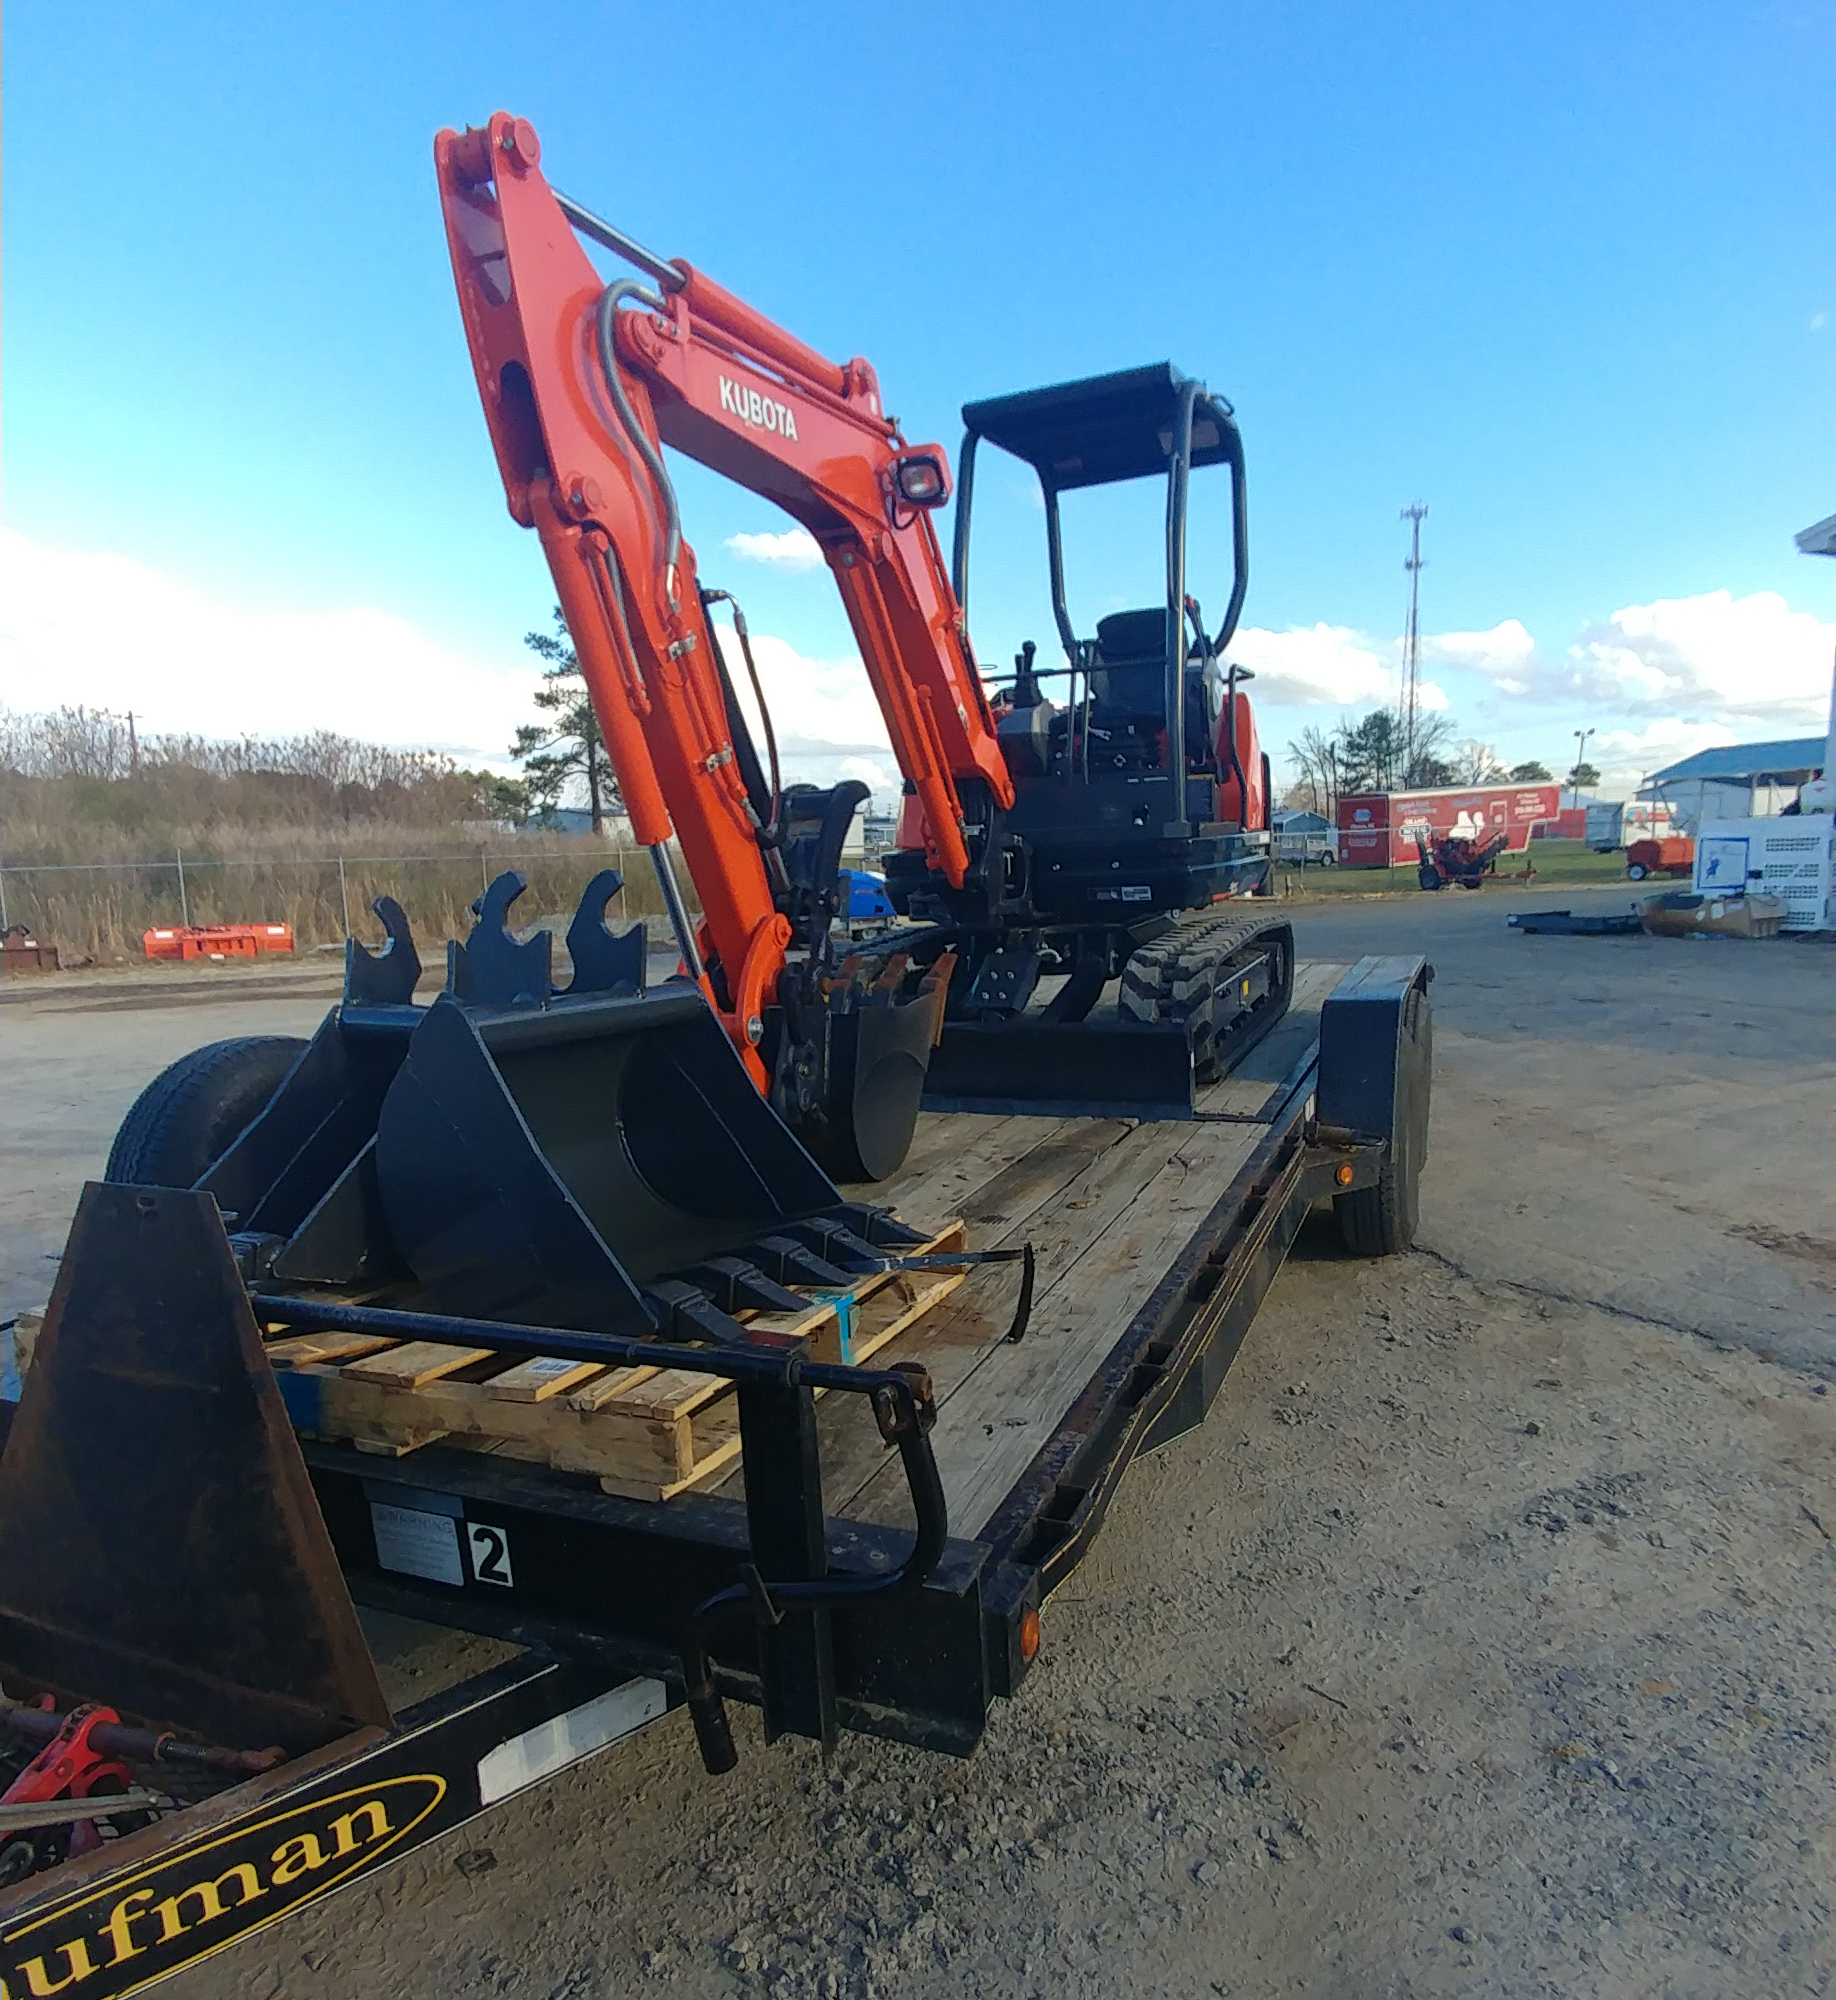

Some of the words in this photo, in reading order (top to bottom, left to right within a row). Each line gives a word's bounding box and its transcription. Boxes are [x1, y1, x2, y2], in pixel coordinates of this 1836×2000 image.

[719, 374, 799, 442] KUBOTA
[473, 1527, 509, 1584] 2
[0, 1800, 396, 2000] ufman
